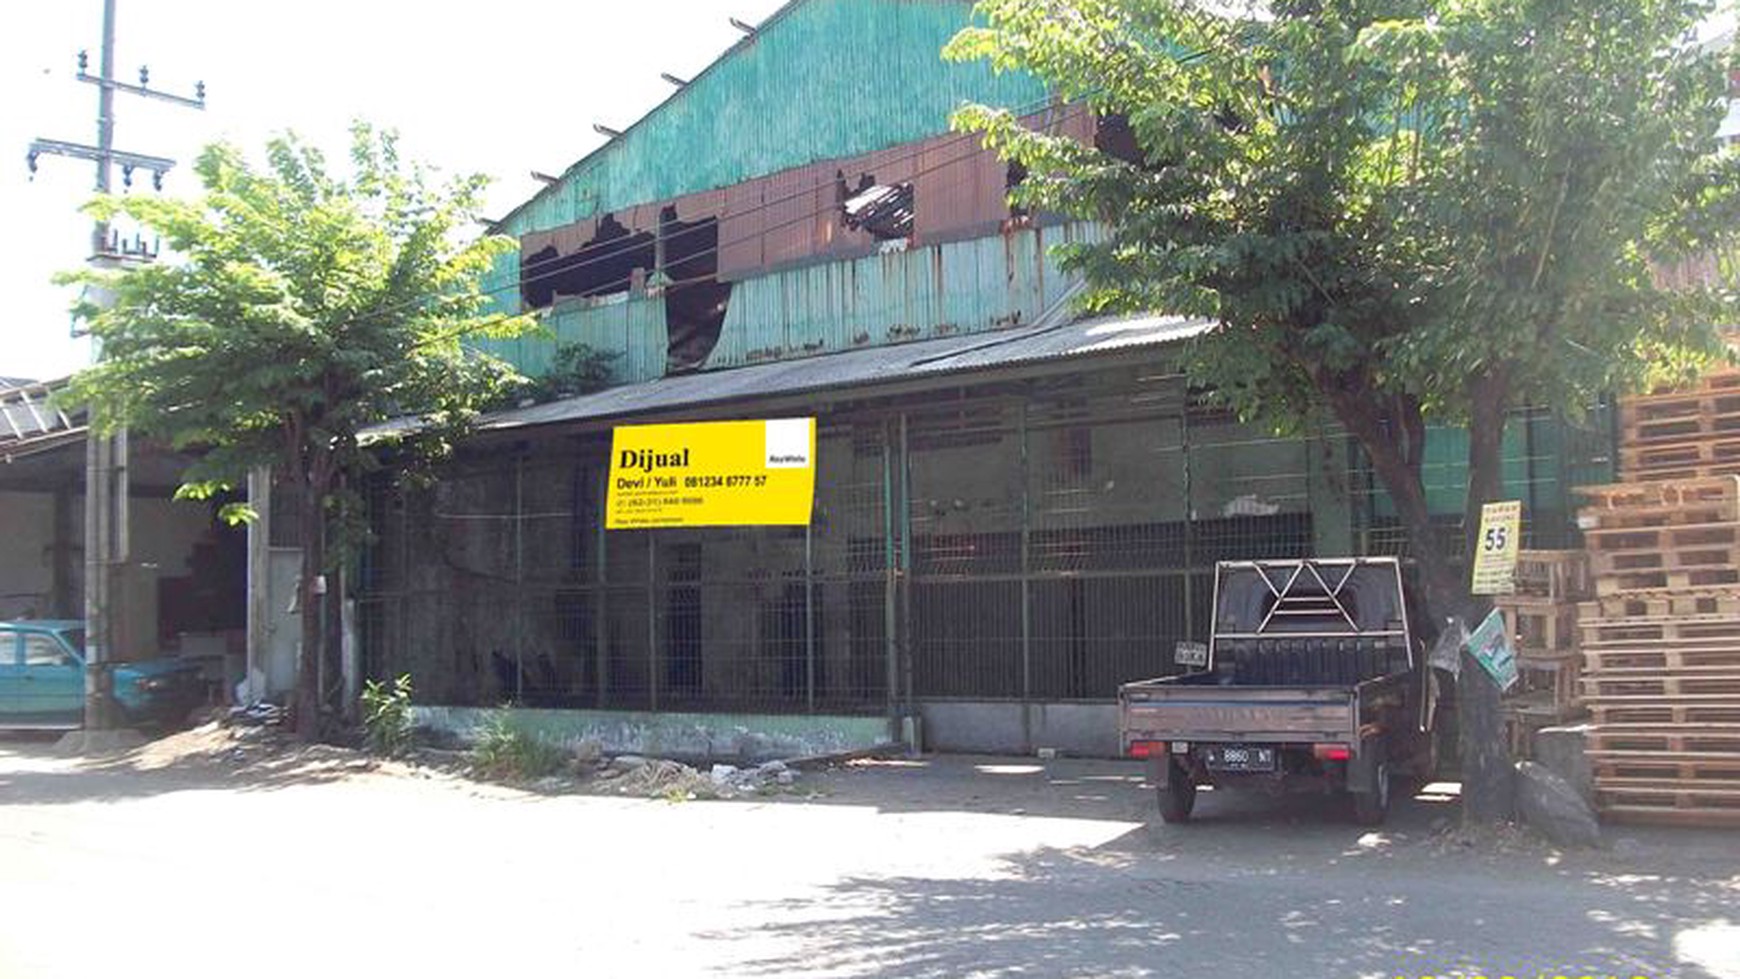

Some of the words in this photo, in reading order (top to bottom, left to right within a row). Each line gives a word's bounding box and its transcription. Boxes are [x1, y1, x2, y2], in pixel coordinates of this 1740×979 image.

[619, 449, 689, 472] Dijual
[617, 476, 644, 490] Devi
[654, 475, 677, 488] Yuli
[1485, 527, 1506, 551] 55
